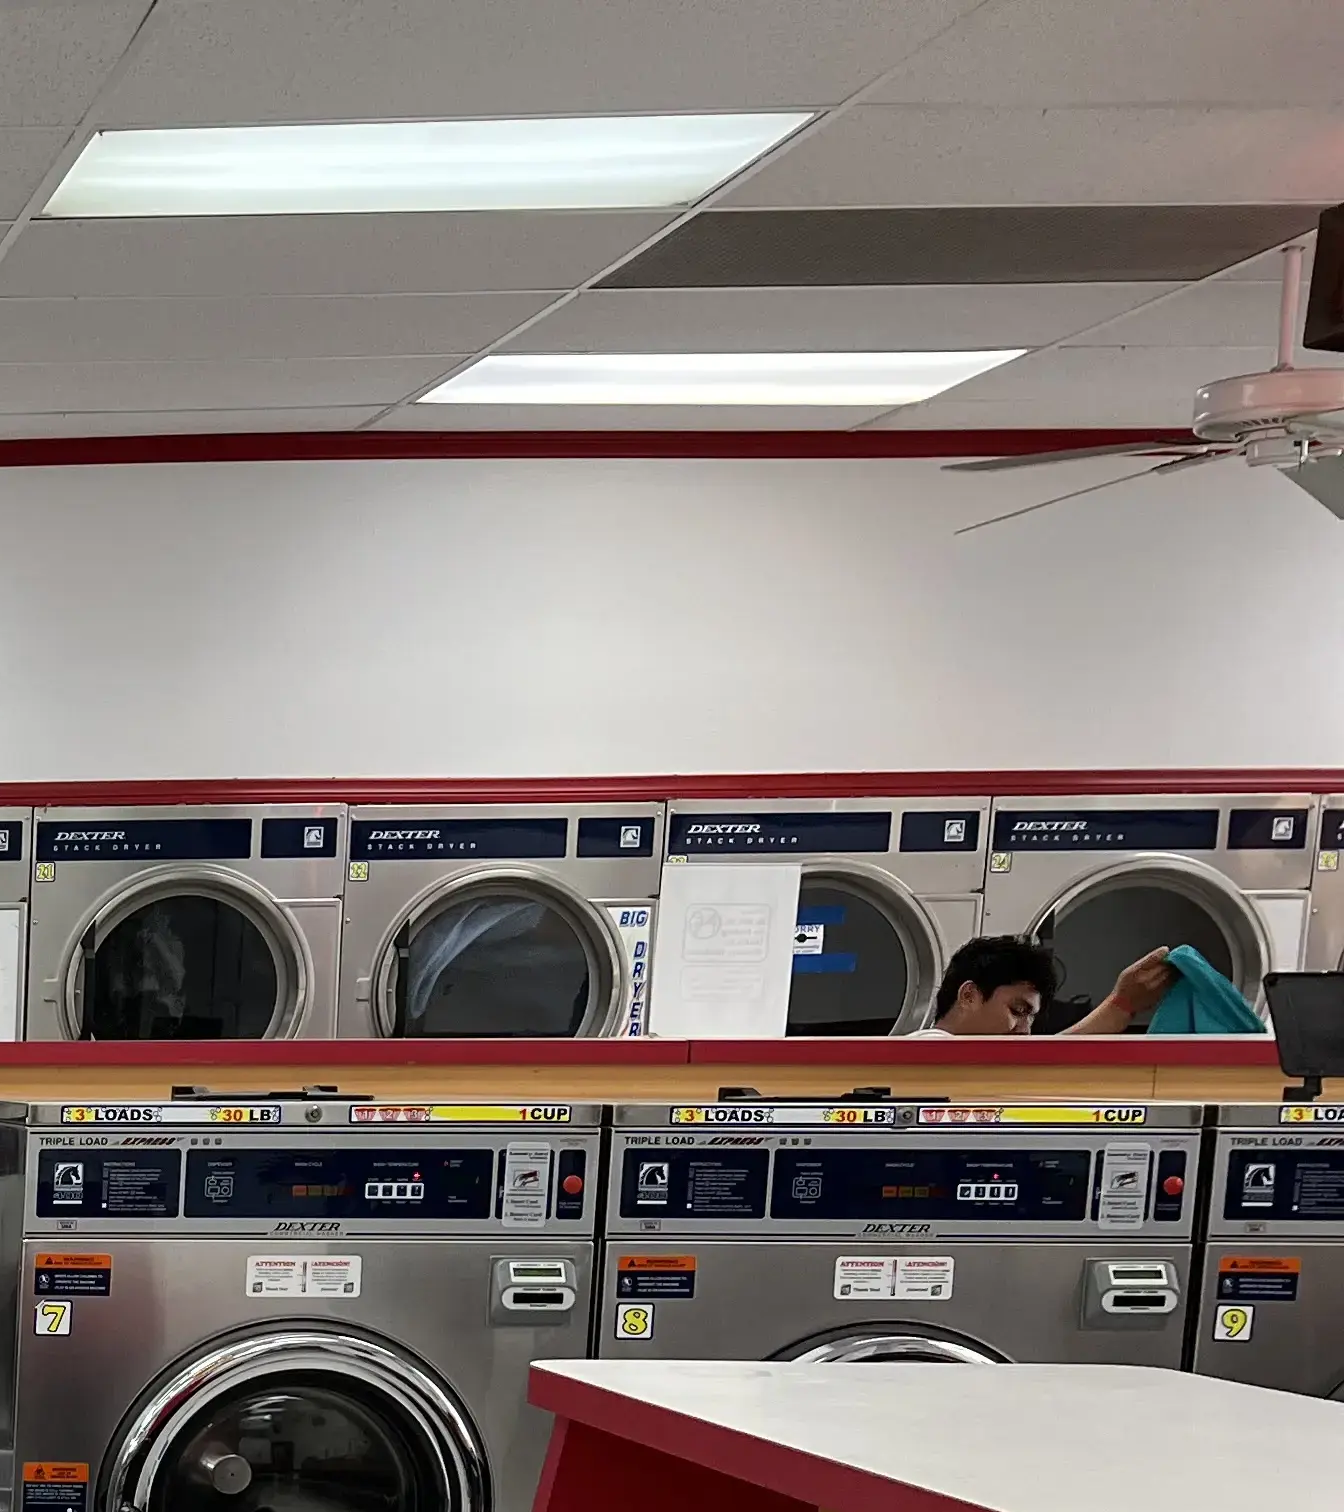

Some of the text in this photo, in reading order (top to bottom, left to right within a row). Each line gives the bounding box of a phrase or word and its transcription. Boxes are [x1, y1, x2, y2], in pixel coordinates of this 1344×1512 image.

[687, 824, 761, 833] DEXTER
[1012, 821, 1088, 831] DEXTER
[54, 831, 126, 841] DEXTER
[369, 830, 441, 840] DEXTER
[993, 853, 1010, 871] 24
[37, 863, 54, 880] 21
[619, 911, 648, 926] BIG
[629, 941, 646, 1036] DRYER
[75, 1109, 271, 1122] 3 LOADS 30 LB
[519, 1109, 527, 1120] 1
[530, 1108, 568, 1121] CUP
[685, 1110, 885, 1123] 3 LOADS 30 LB
[1092, 1110, 1101, 1122] 1
[1104, 1109, 1143, 1122] CUP
[1293, 1108, 1344, 1121] 3 LOA
[39, 1137, 176, 1146] TRIPLE LOAD EXPRESS
[625, 1136, 764, 1146] TRIPLE LOAD EXPRESS
[1231, 1138, 1302, 1146] TRIPLE LOAD
[273, 1222, 341, 1231] DEXTER
[862, 1224, 931, 1233] DEXTER
[42, 1305, 66, 1332] 7
[622, 1308, 649, 1335] 8
[1222, 1309, 1247, 1338] 9
